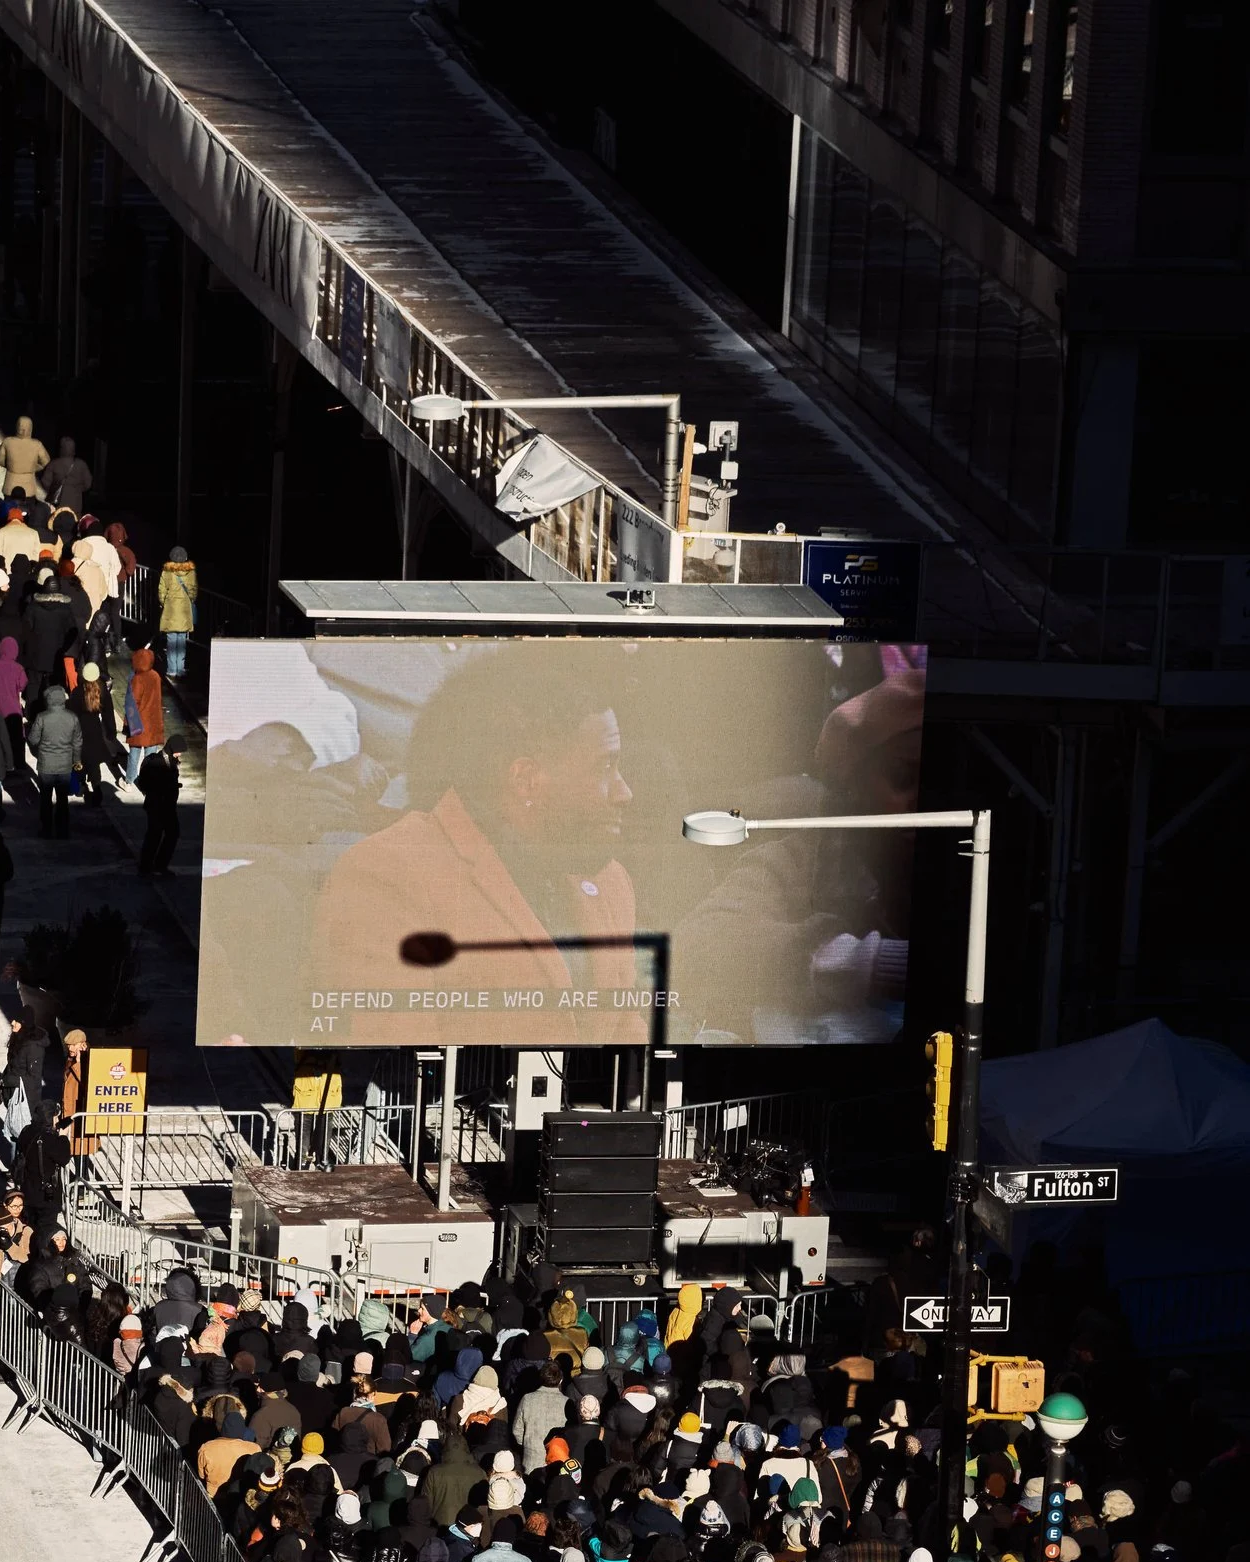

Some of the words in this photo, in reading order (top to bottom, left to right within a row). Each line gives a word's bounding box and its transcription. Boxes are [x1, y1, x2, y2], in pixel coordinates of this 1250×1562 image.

[311, 992, 394, 1009] DEFEND
[408, 991, 489, 1008] PEOPLE
[503, 991, 544, 1007] WHO
[558, 991, 598, 1007] ARE
[613, 991, 681, 1007] UNDER
[310, 1016, 339, 1032] AT
[94, 1085, 138, 1096] ENTER
[98, 1102, 133, 1113] HERE
[1033, 1178, 1094, 1197] Fulton
[1097, 1176, 1110, 1187] ST
[817, 1273, 823, 1281] 6
[1052, 1495, 1061, 1504] A
[1051, 1512, 1060, 1521] C
[1050, 1529, 1058, 1538] E
[1049, 1547, 1056, 1556] J
